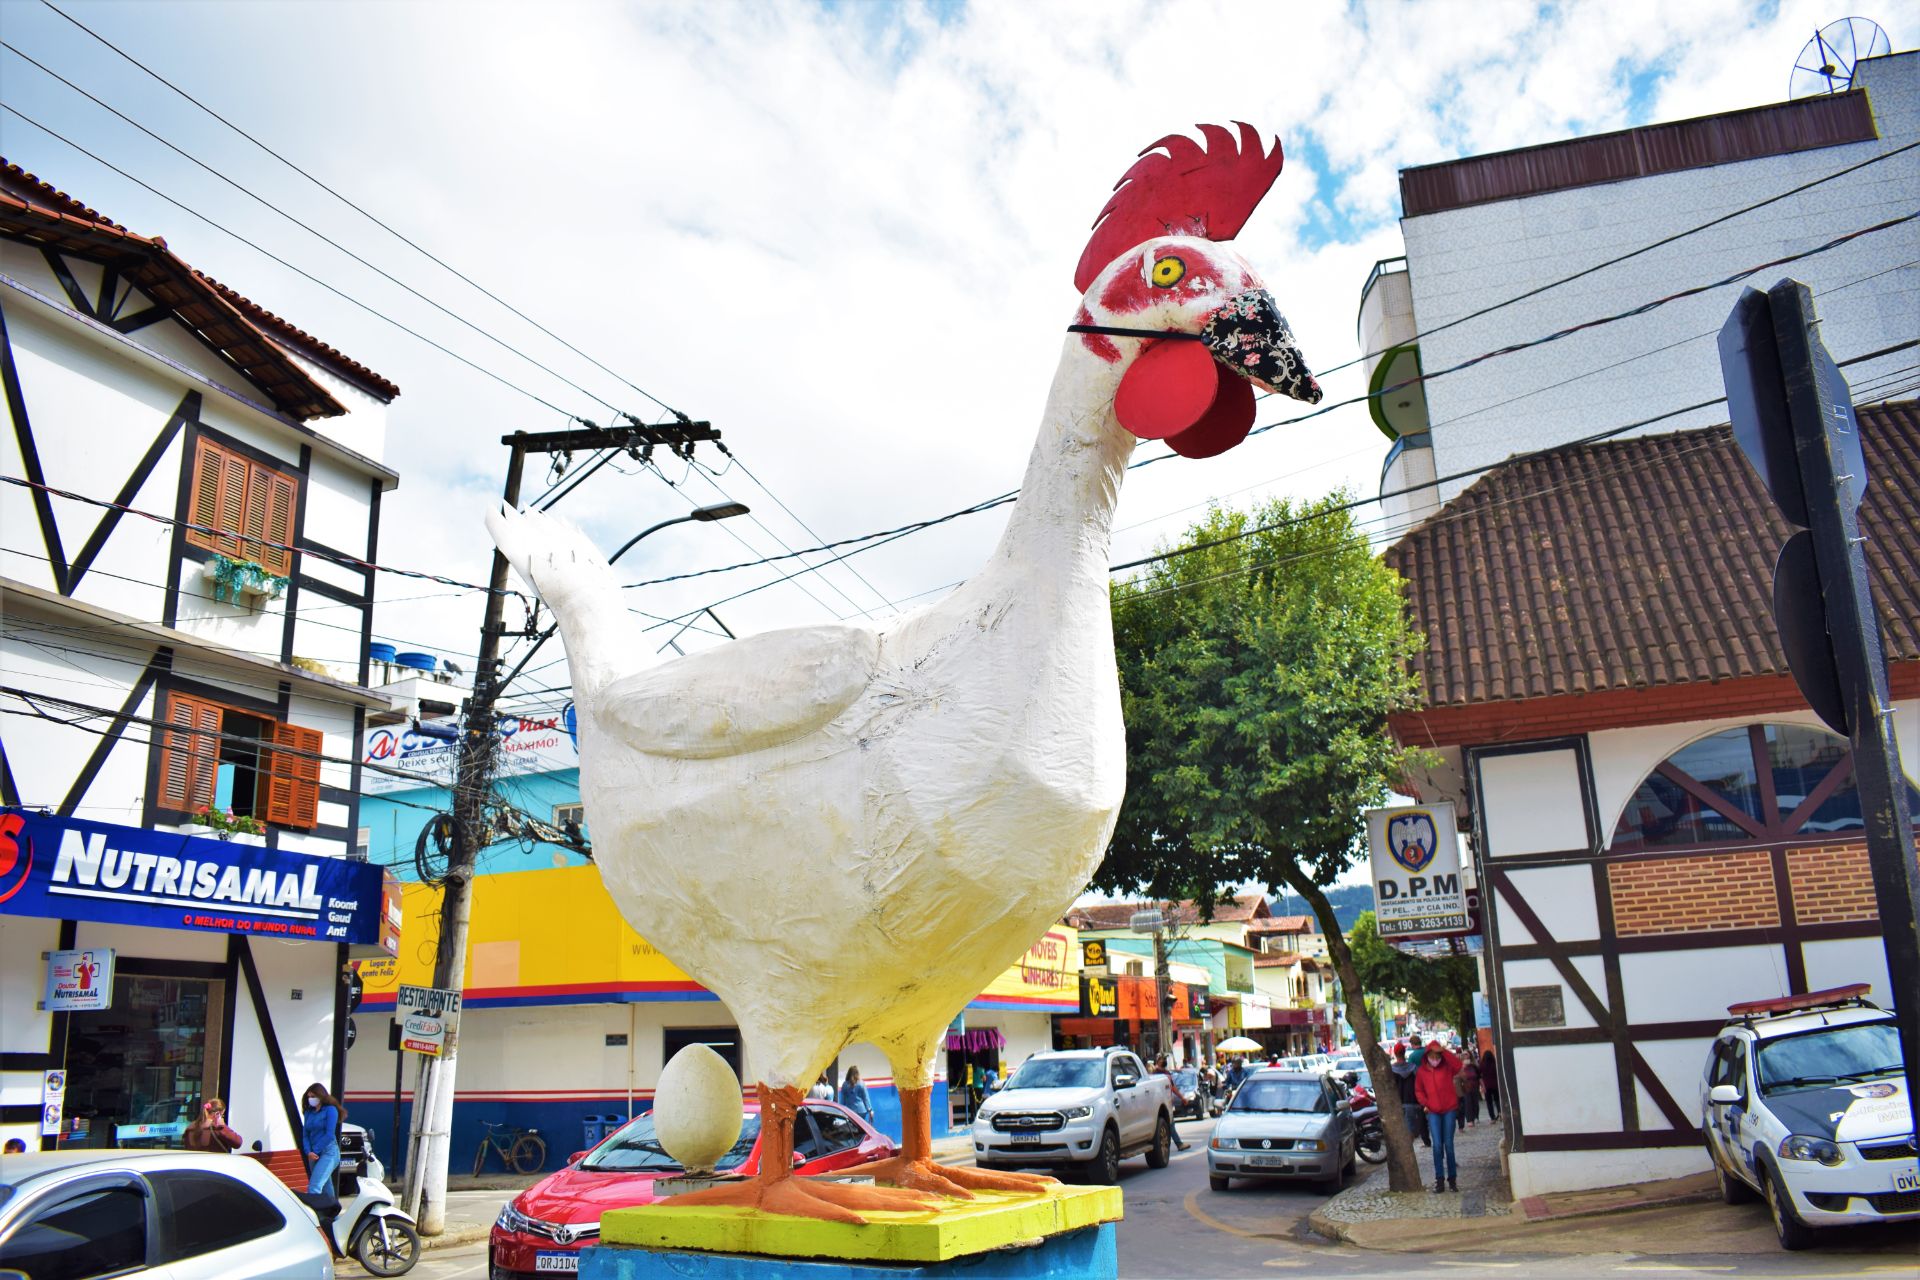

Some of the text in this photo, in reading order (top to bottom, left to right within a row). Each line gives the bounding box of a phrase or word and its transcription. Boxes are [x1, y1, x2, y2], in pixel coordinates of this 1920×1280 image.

[397, 755, 450, 769] Deixe seu
[51, 828, 322, 910] NUTRISAMAL
[328, 897, 358, 911] Koomt
[1442, 902, 1460, 910] IND.
[328, 911, 352, 924] Gaud
[1397, 919, 1413, 931] 190
[1420, 915, 1464, 930] 3263-1139
[183, 914, 317, 936] O MELHOR DO MUNDO RURAL
[326, 925, 348, 937] Ant!
[361, 968, 394, 979] gente Feliz
[398, 985, 460, 1013] RESTAURANTE
[540, 1256, 578, 1270] QRJ1D4
